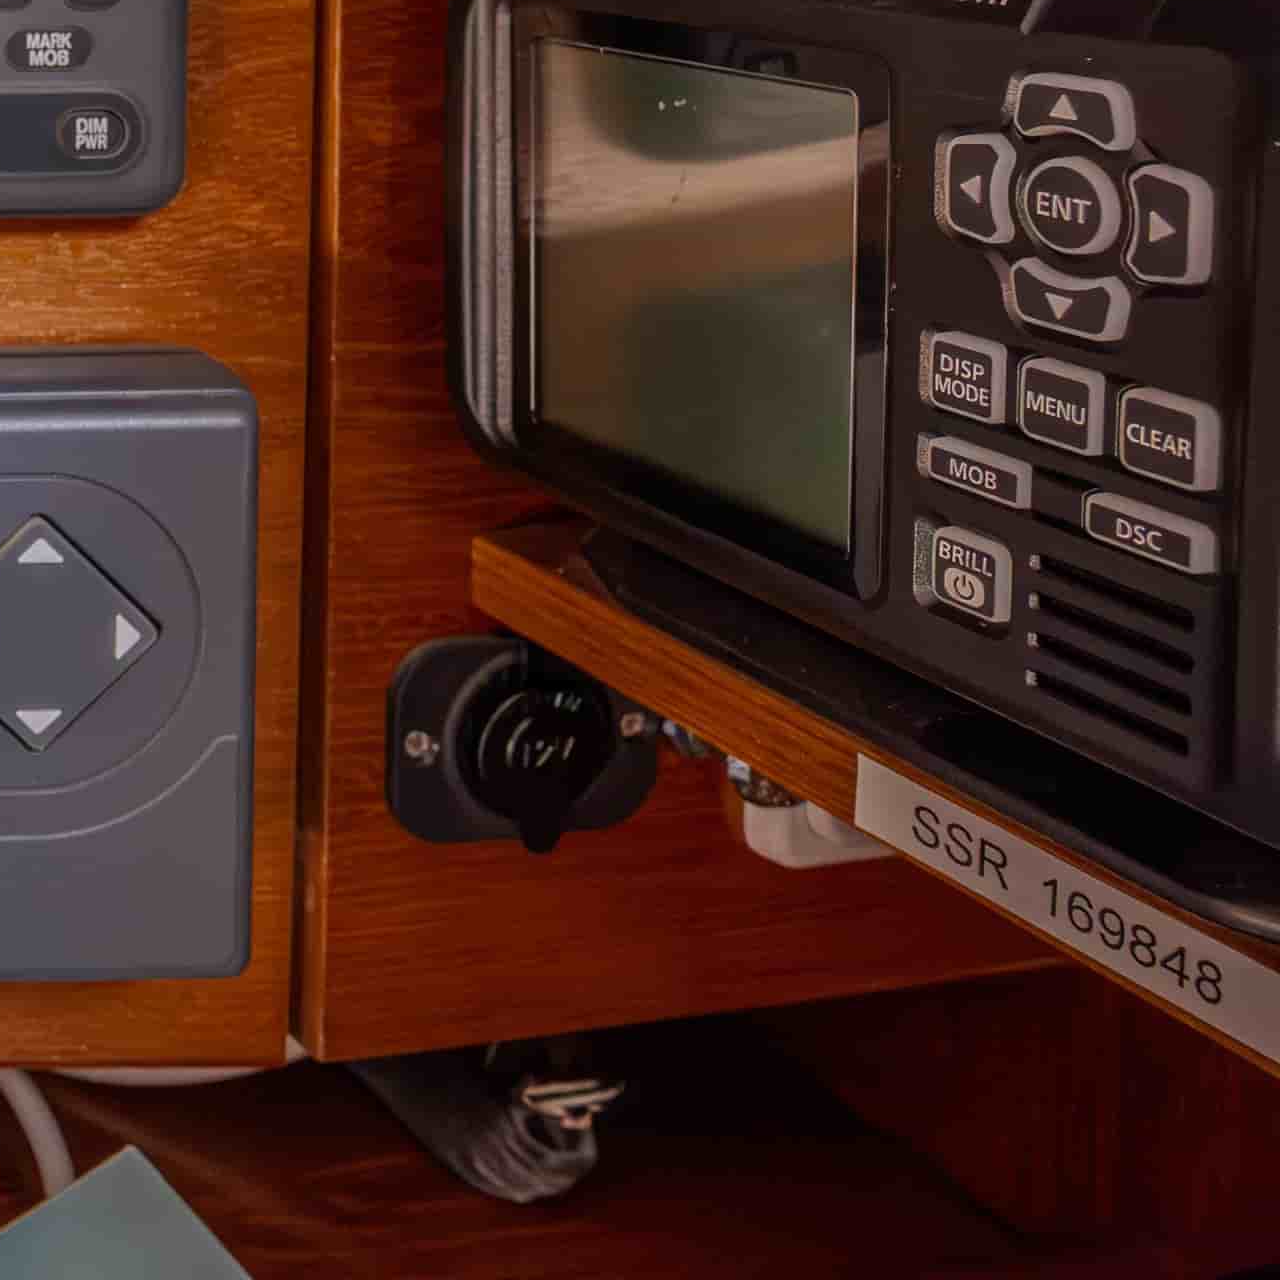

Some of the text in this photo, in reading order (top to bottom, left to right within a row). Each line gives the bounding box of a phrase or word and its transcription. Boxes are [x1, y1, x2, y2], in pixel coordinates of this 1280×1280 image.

[26, 31, 73, 50] MARK
[29, 49, 70, 68] MOB
[75, 117, 108, 135] DIM
[75, 133, 108, 151] PWR
[1034, 189, 1093, 226] ENT
[940, 352, 985, 382] DISP
[934, 373, 990, 407] MODE
[1025, 390, 1086, 426] MENU
[1126, 423, 1193, 460] CLEAR
[949, 457, 998, 491] MOB
[1115, 517, 1164, 552] DSC
[938, 539, 993, 577] BRILL
[911, 804, 1224, 1006] SSR 169848
